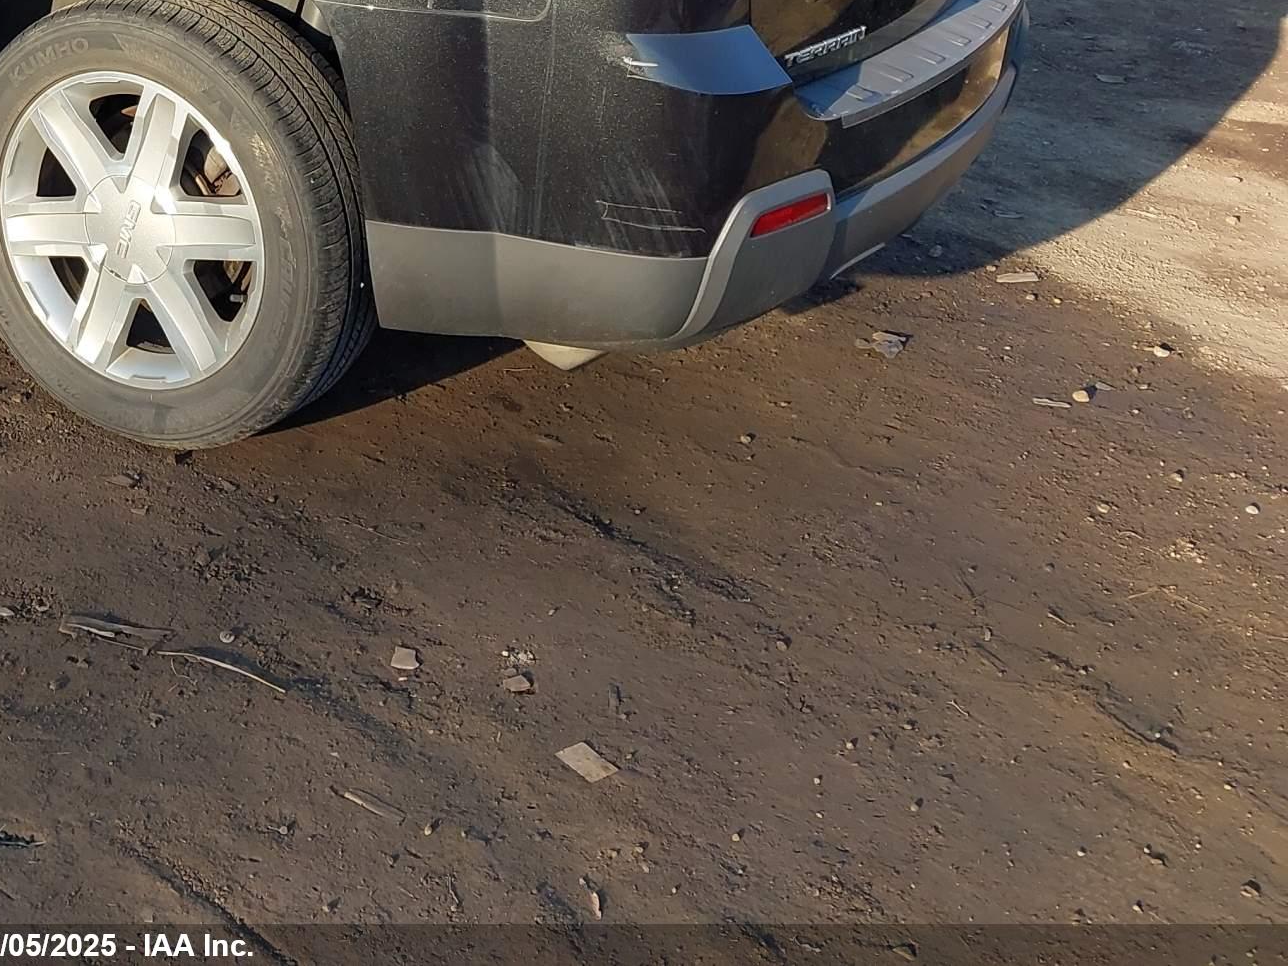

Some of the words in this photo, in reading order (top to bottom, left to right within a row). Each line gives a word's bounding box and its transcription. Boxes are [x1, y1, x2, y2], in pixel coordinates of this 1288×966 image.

[9, 37, 89, 87] KUMHO
[784, 25, 867, 67] TERRAIN
[116, 200, 142, 259] GMC
